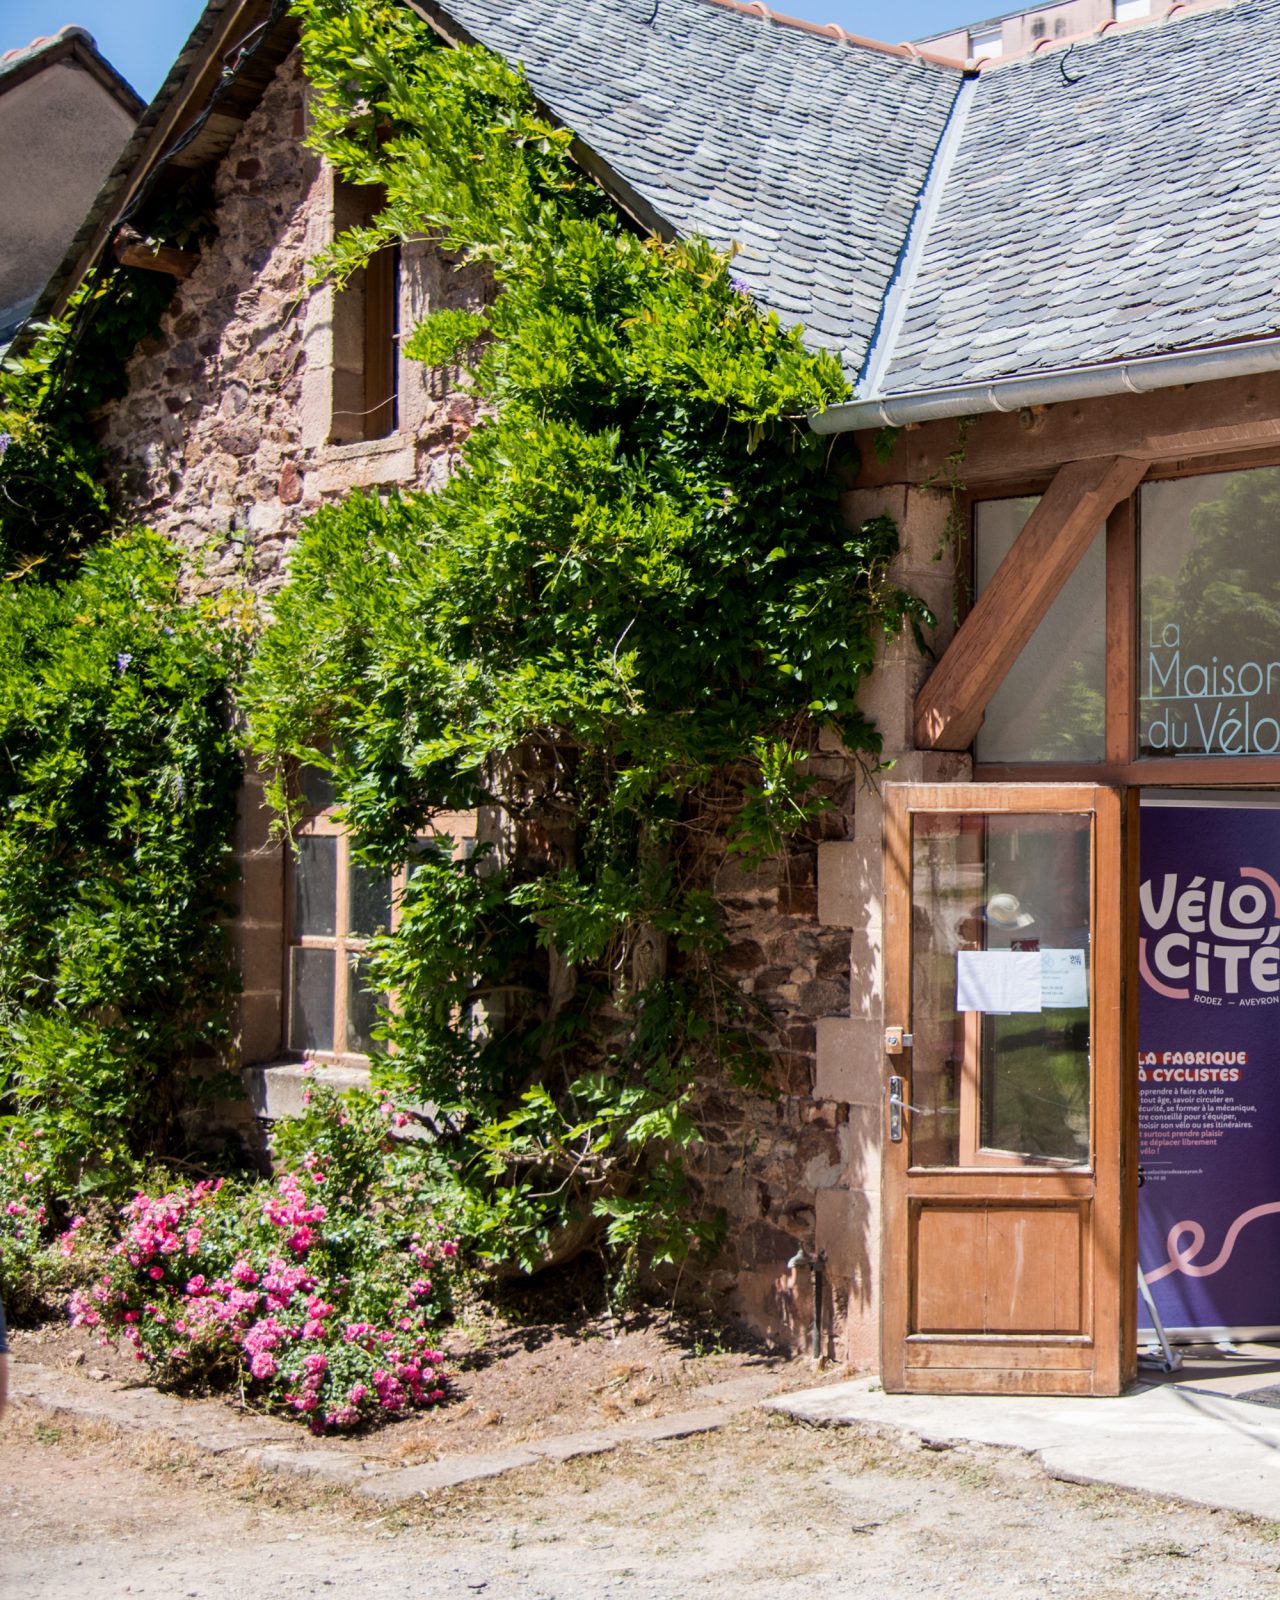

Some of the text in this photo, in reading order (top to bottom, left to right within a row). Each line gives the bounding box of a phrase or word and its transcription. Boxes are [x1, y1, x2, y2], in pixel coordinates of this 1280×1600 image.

[1148, 616, 1181, 648] La
[1148, 701, 1280, 753] du Vélo
[1139, 873, 1267, 941] VÉLO
[1193, 994, 1223, 1006] RODEZ
[1239, 995, 1280, 1007] AVEYRON
[1138, 1051, 1247, 1066] LA FABRIQUE
[1138, 1066, 1240, 1082] À CYCLISTES
[1138, 1087, 1225, 1097] pprendre à faire du vélo
[1140, 1096, 1156, 1104] tout
[1172, 1096, 1195, 1104] savoir
[1195, 1095, 1224, 1103] circuler
[1138, 1104, 1166, 1113] écurité,
[1175, 1104, 1201, 1112] former
[1201, 1104, 1207, 1112] à
[1207, 1103, 1215, 1112] la
[1215, 1103, 1257, 1114] mécanique,
[1138, 1113, 1149, 1121] tre
[1150, 1112, 1183, 1121] conseillé
[1183, 1114, 1201, 1123] pour
[1138, 1120, 1160, 1129] hoisir
[1174, 1120, 1191, 1129] vélo
[1215, 1120, 1254, 1129] itinéraires.
[1171, 1129, 1200, 1139] prendre
[1200, 1129, 1224, 1138] plaisir
[1149, 1138, 1181, 1147] déplacer
[1181, 1138, 1217, 1146] librement
[1139, 1146, 1156, 1155] vélo
